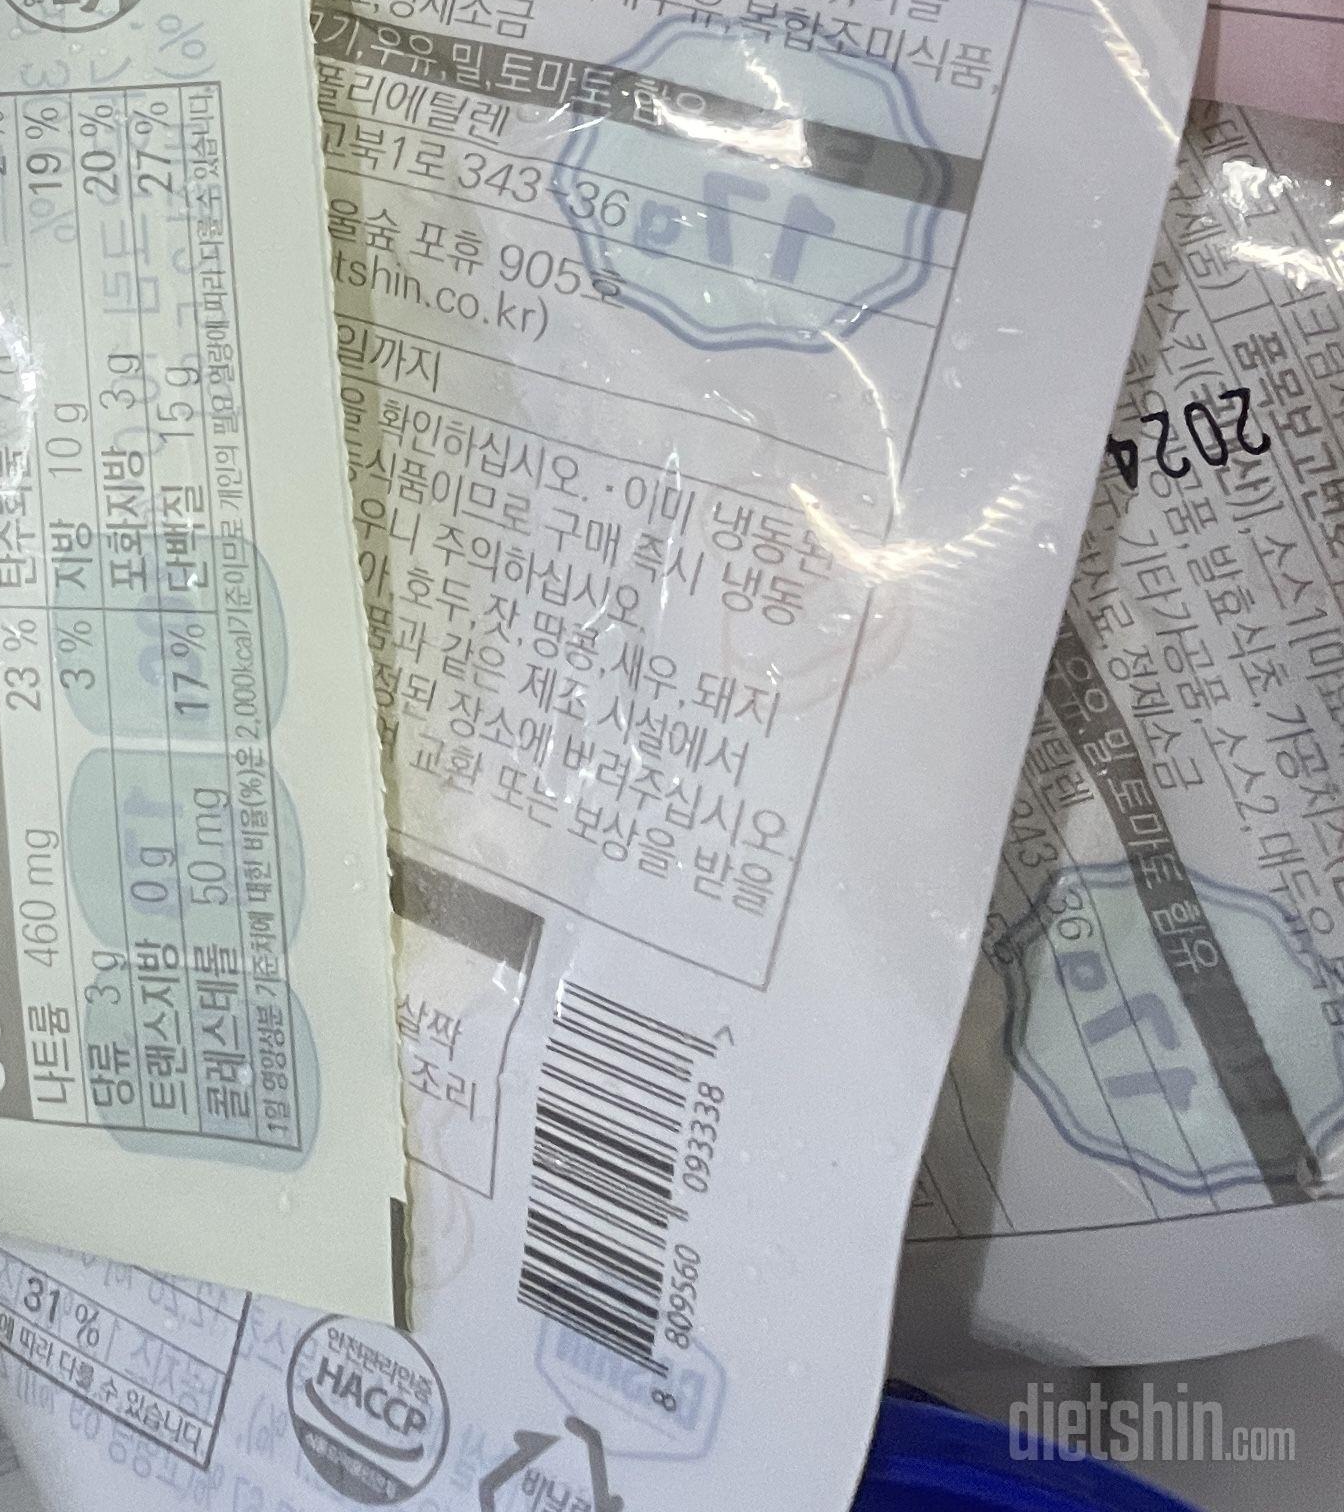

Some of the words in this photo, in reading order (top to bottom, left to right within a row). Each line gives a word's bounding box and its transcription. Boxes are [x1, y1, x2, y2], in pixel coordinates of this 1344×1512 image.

[457, 152, 629, 227] 343-36
[45, 436, 83, 476] 10
[49, 520, 94, 589] 지방
[102, 447, 148, 590] 포화지방
[160, 485, 209, 592] 단백질
[547, 508, 622, 567] 구매
[721, 564, 803, 626] 냉동
[25, 828, 60, 886] mg
[187, 860, 229, 906] 50
[21, 900, 58, 968] 460
[28, 1004, 74, 1104] 나트륨
[135, 940, 188, 1113] 트랜스지방
[193, 944, 250, 1118] 콜레스테롤
[317, 1357, 427, 1434] HACCP
